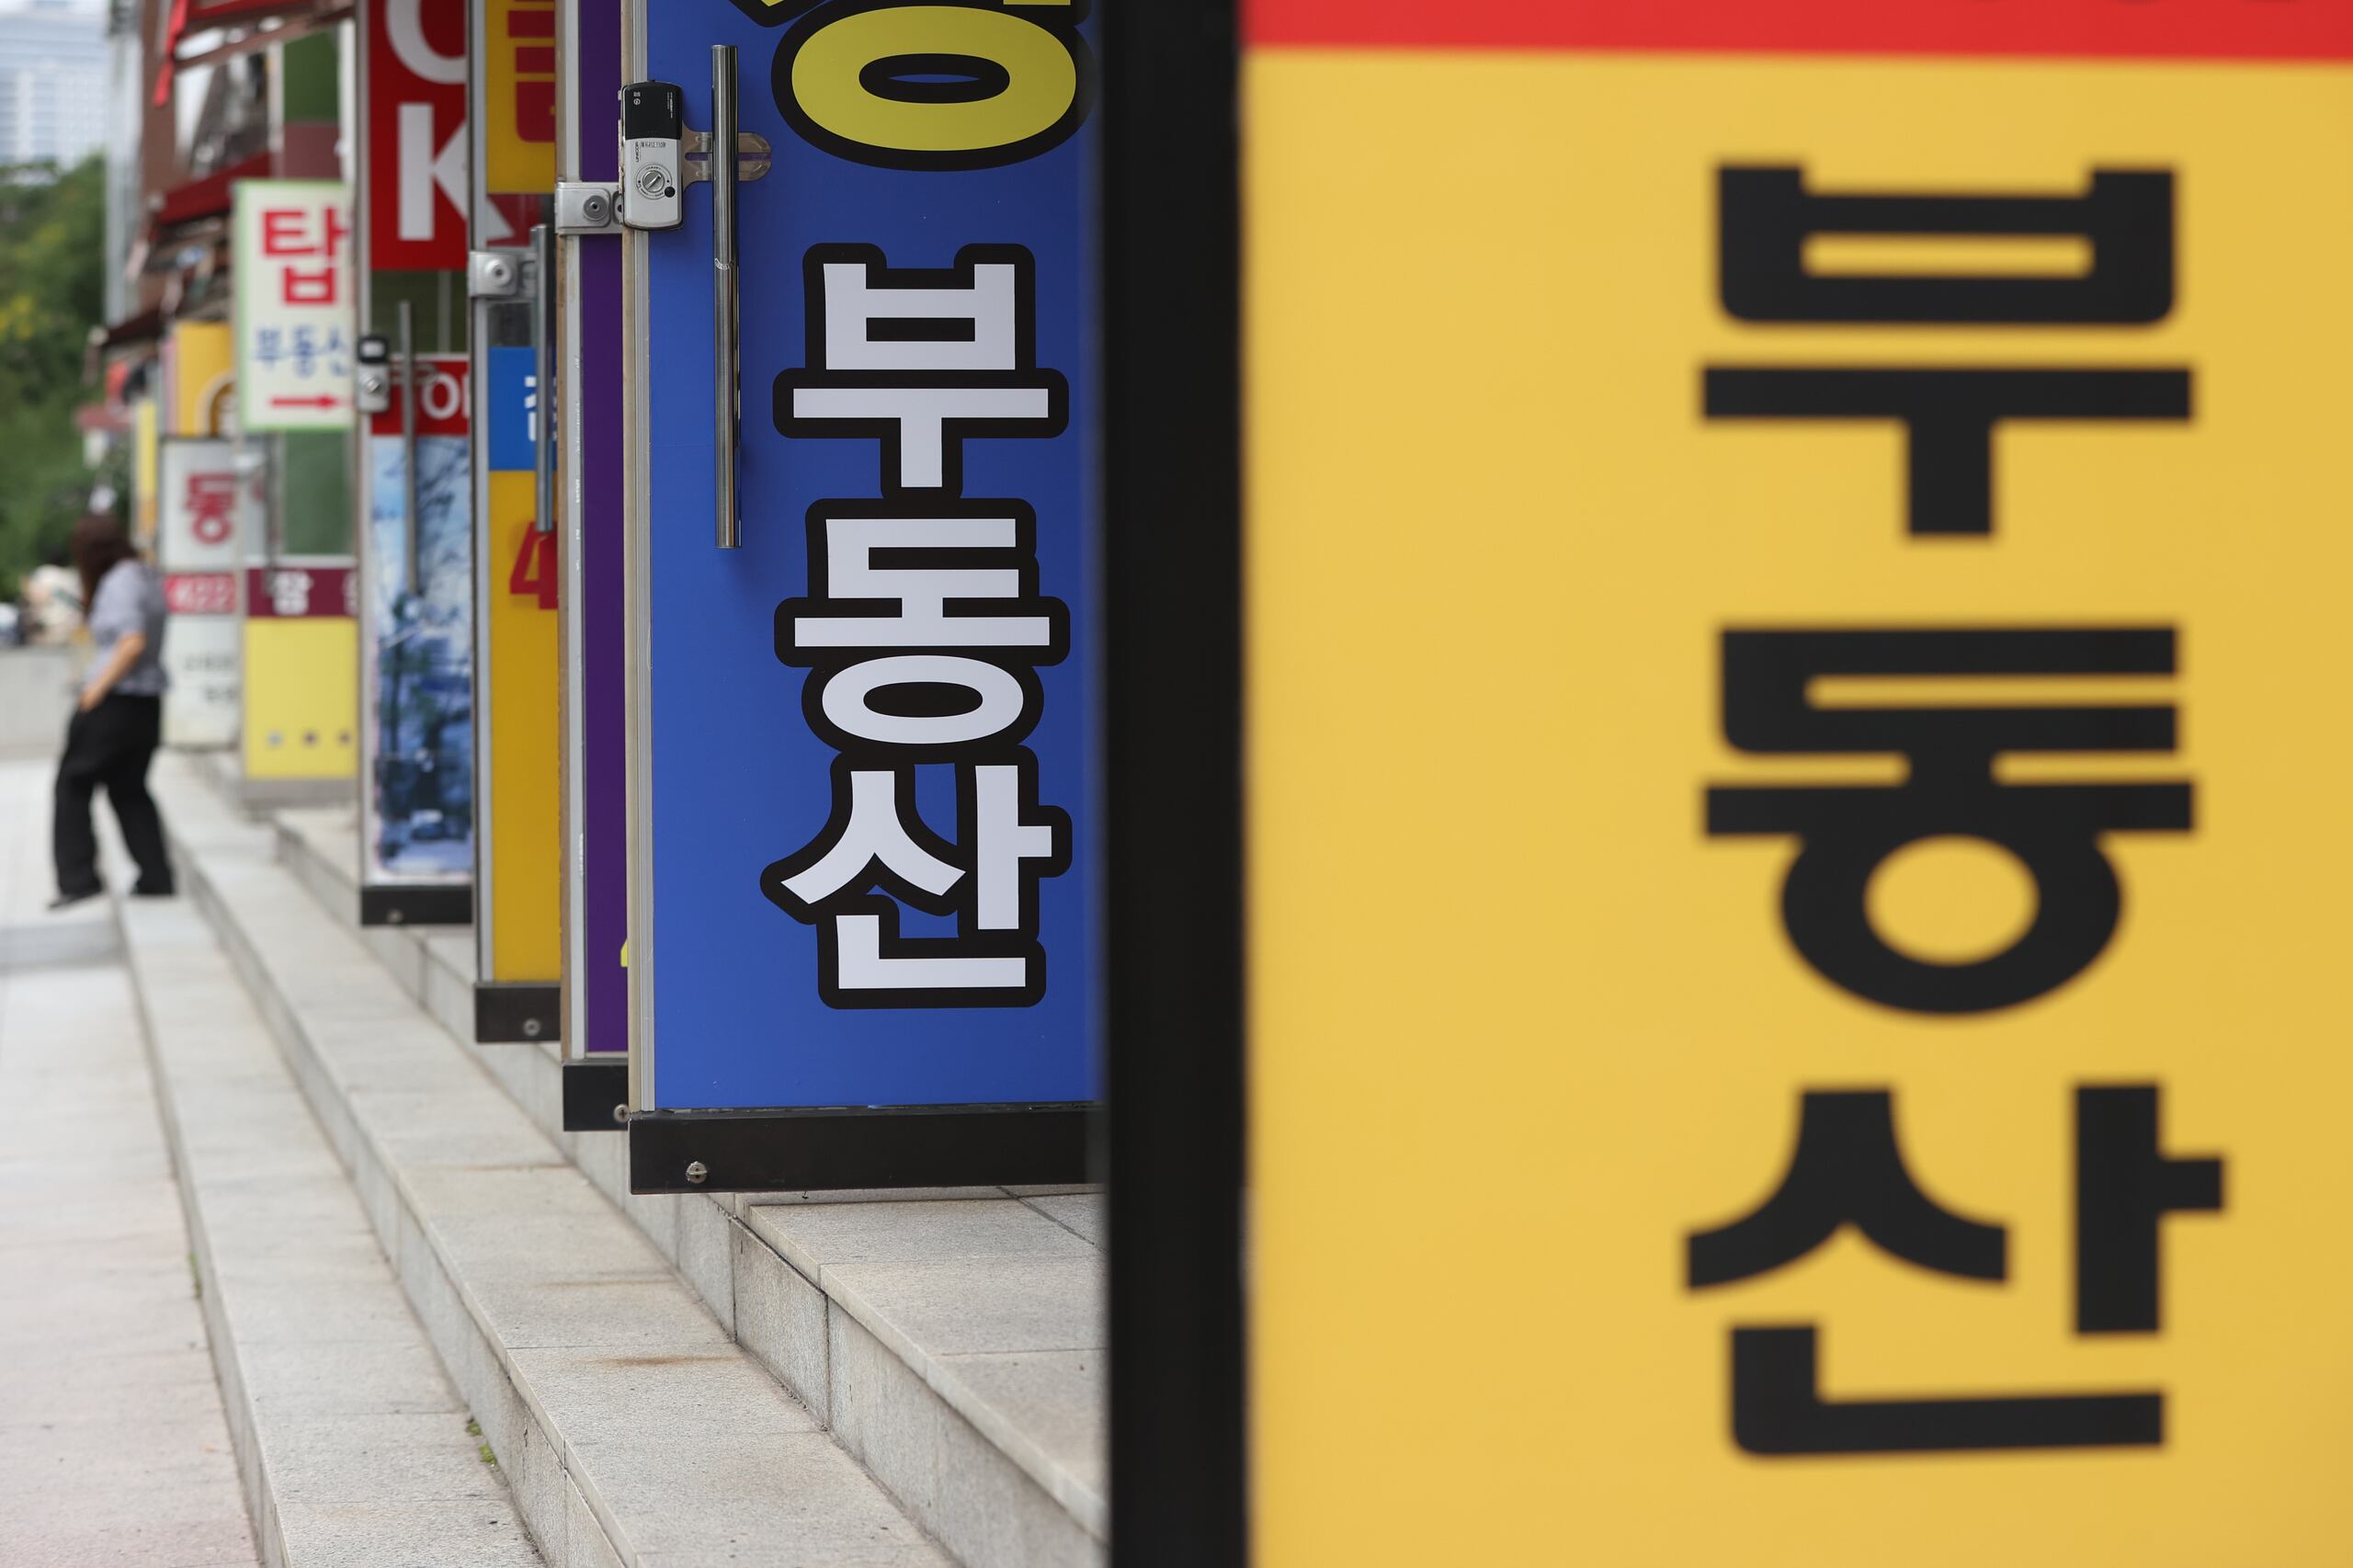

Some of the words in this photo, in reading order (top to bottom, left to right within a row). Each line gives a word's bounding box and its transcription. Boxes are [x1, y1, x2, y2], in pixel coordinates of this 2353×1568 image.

[262, 208, 350, 305] 탑
[772, 256, 1059, 996] 부동산
[1682, 162, 2228, 1456] 부동산
